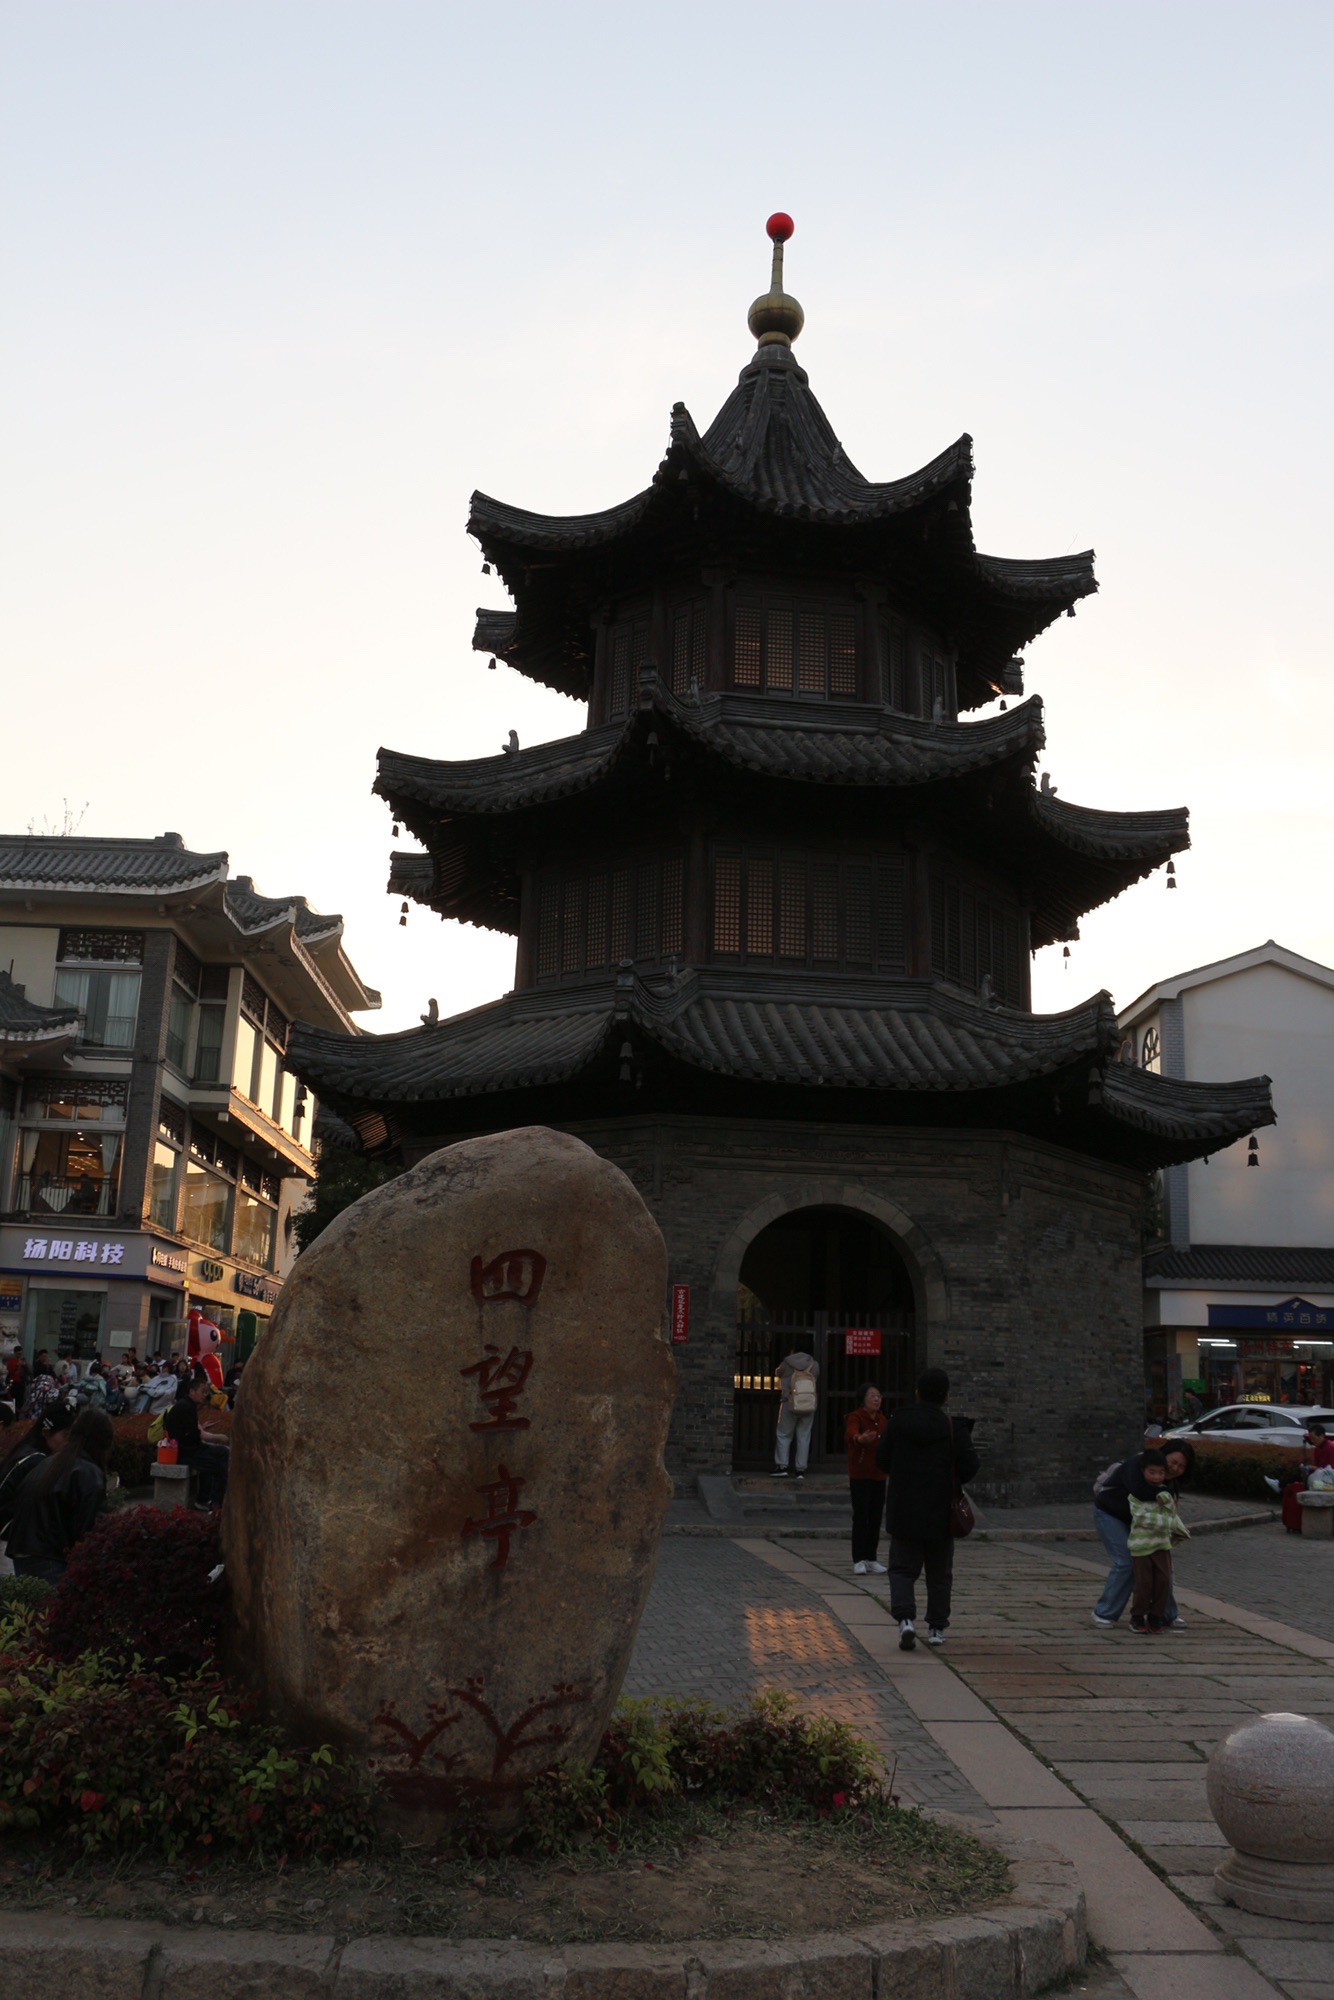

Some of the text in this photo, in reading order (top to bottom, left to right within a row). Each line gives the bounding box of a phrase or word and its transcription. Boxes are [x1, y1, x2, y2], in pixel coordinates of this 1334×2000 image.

[23, 1238, 125, 1264] 扬阳科技
[460, 1248, 547, 1570] 四望亭
